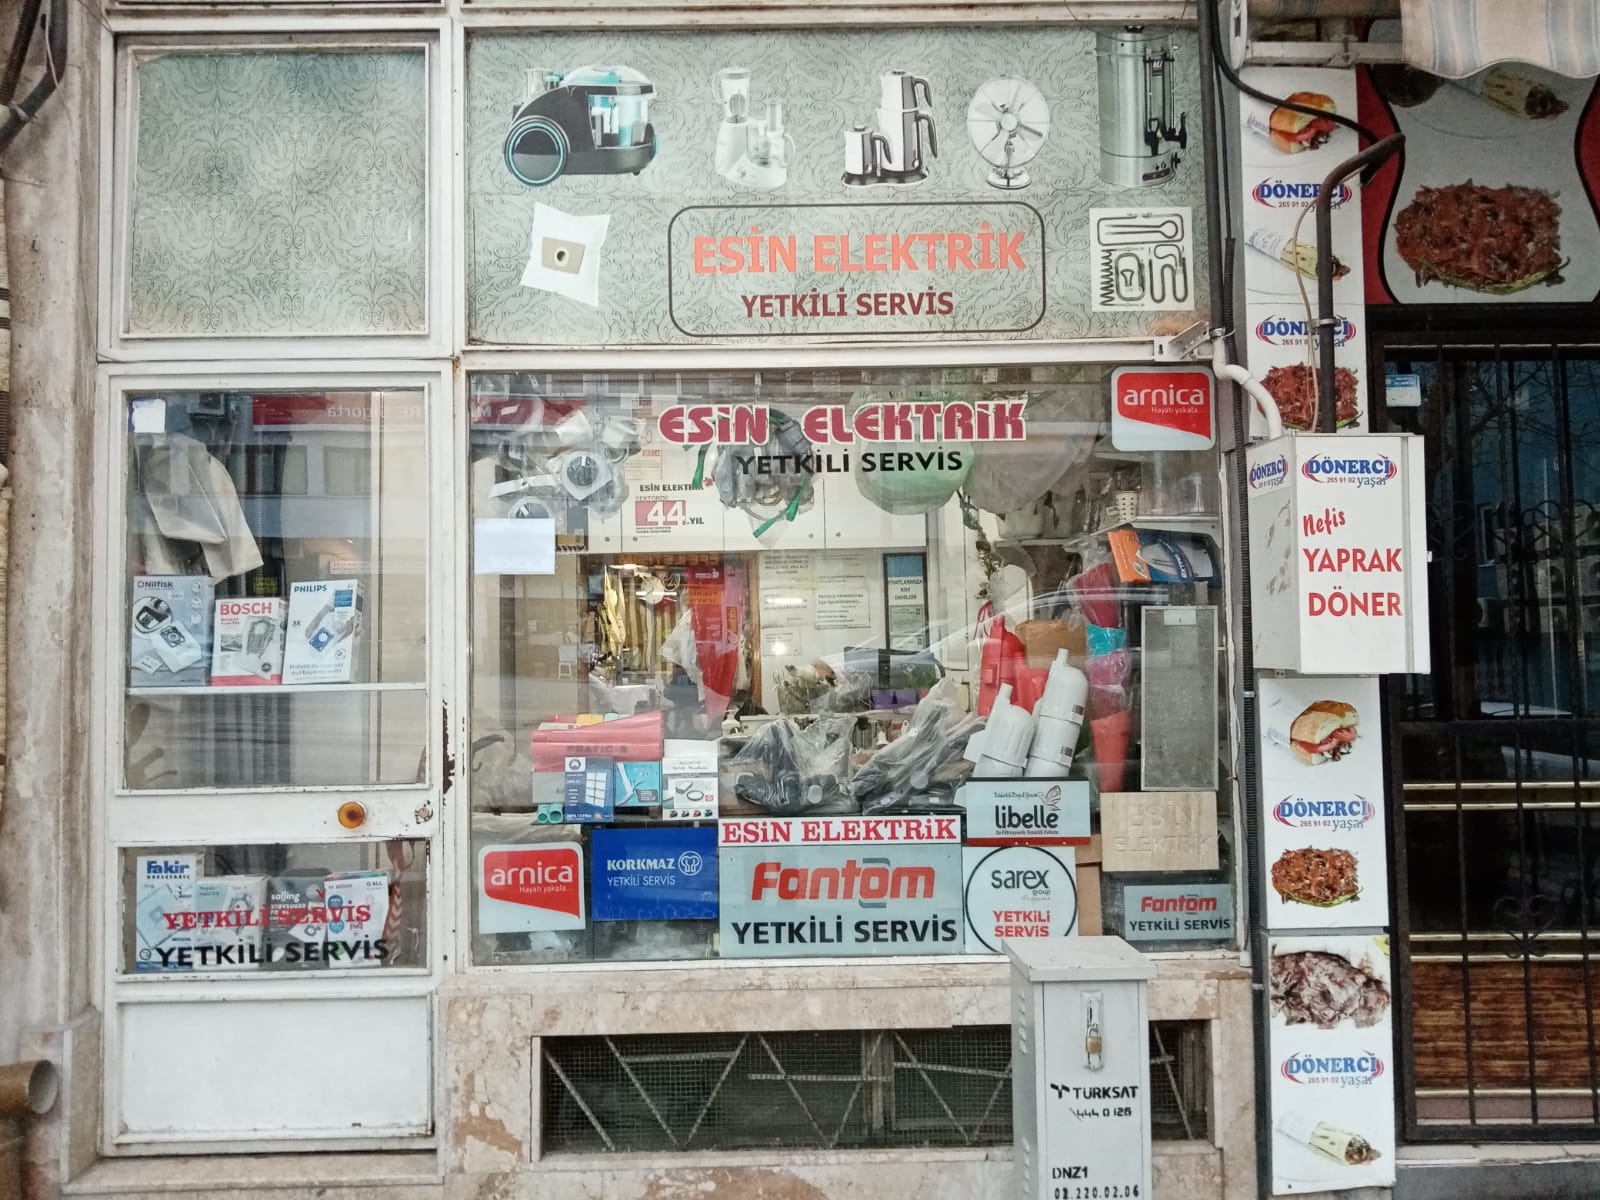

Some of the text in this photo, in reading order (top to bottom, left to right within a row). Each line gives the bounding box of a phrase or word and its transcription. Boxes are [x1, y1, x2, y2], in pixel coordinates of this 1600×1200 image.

[694, 221, 1027, 274] ESİN ELEKTRİK
[742, 286, 954, 318] YETKİLİ SERVİS
[1263, 317, 1349, 336] DÖNİ
[1123, 384, 1204, 405] arnica
[736, 447, 963, 475] YETKİLİ SERVİS
[1308, 457, 1390, 474] DÖNERCİ
[1303, 507, 1346, 537] Nefis
[1302, 548, 1403, 572] YAPRAK
[294, 584, 327, 593] PHILIPS
[220, 602, 272, 615] BOSCH
[1308, 586, 1403, 617] DÖNER
[995, 805, 1059, 829] libelle
[1280, 797, 1368, 817] DÖNERCİ
[147, 861, 190, 874] Fakir
[491, 861, 573, 885] arnica
[607, 858, 675, 870] KORKMAZ
[607, 873, 676, 886] YETKİLİ SERVİS
[751, 859, 935, 901] Fantom
[991, 870, 1050, 889] sarex
[1141, 895, 1217, 913] Fantom
[731, 914, 958, 945] YETKİLİ SERVİS
[1129, 916, 1230, 931] YETKİLİ SERVİS
[1288, 1053, 1376, 1074] DÖNERCİ
[1052, 1166, 1088, 1179] DNZ1
